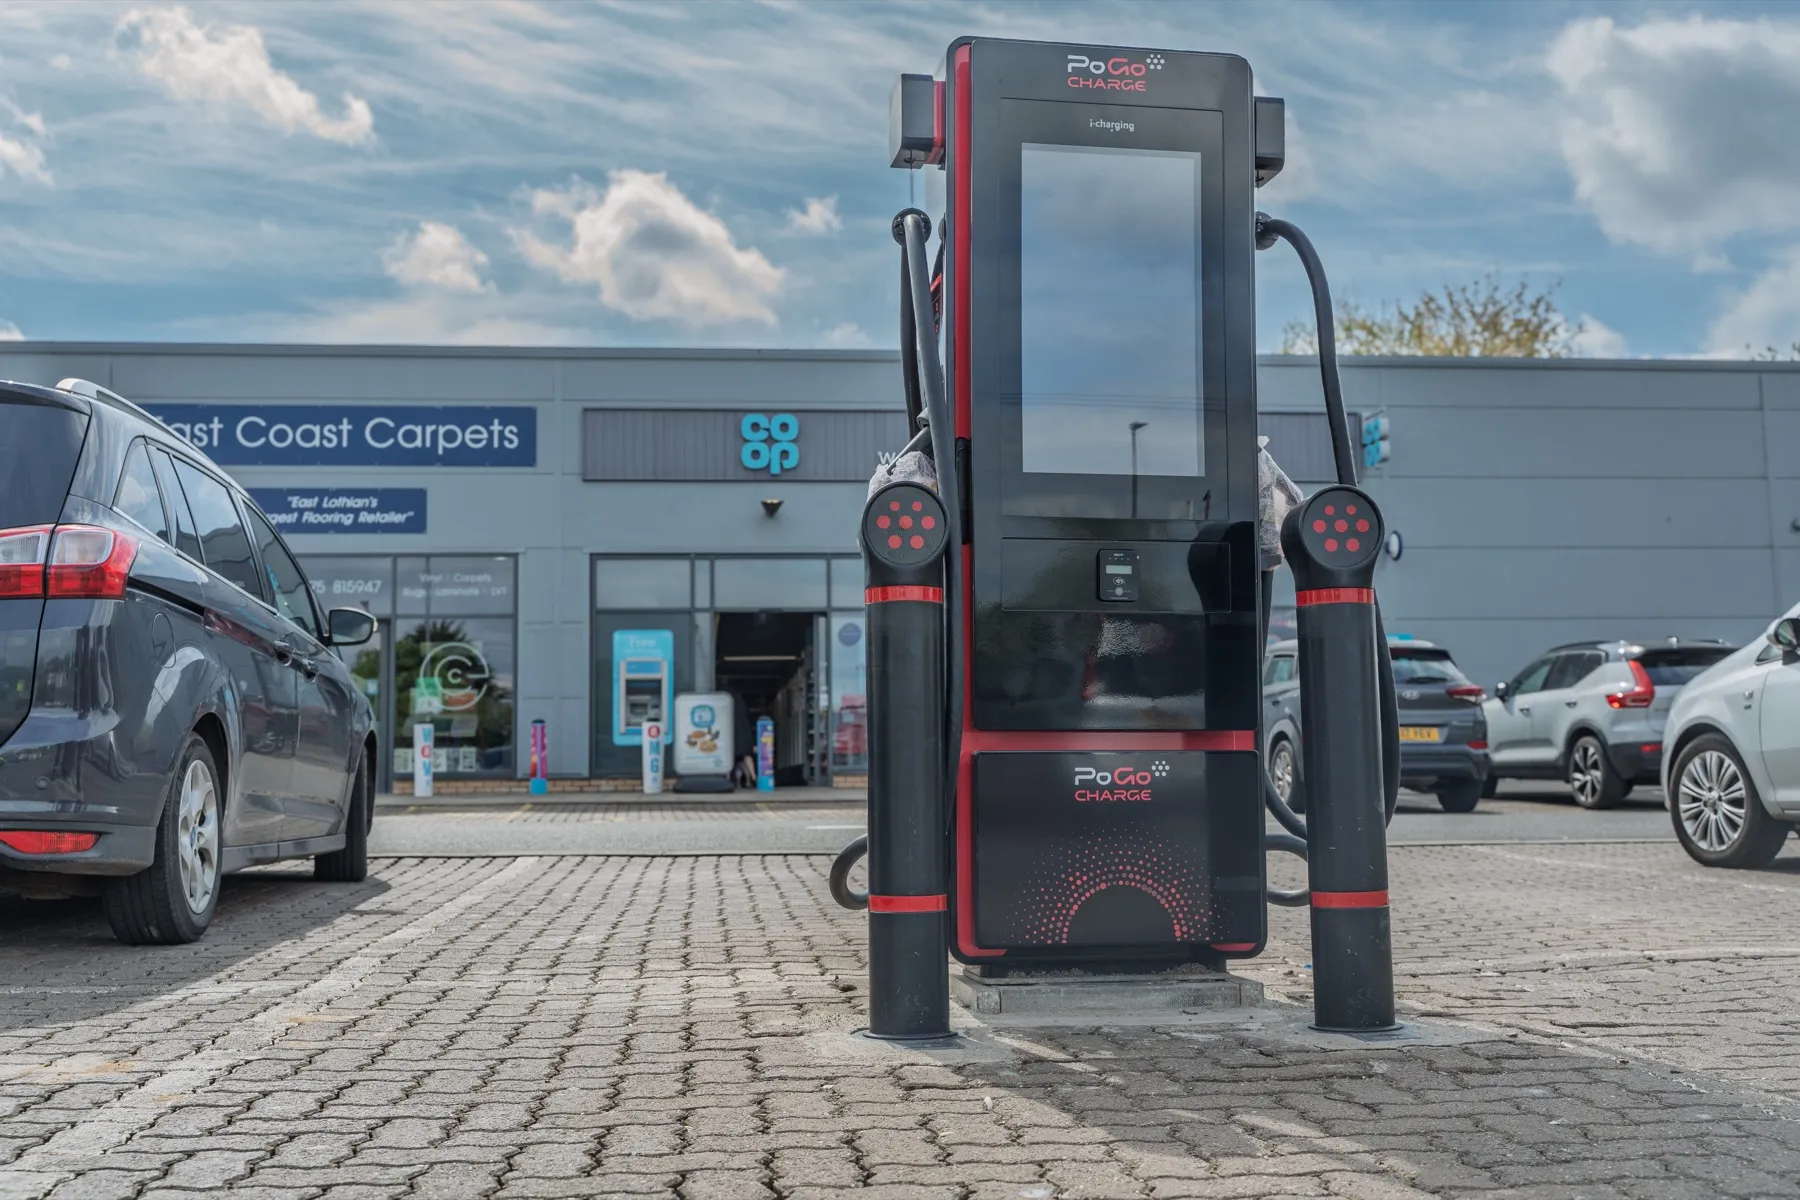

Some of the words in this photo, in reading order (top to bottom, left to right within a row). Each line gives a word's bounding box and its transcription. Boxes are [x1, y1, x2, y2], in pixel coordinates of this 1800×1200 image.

[1067, 54, 1147, 77] PoGo
[1067, 76, 1147, 92] CHARGE
[1089, 118, 1135, 132] i-charging
[157, 415, 224, 448] ast
[235, 415, 353, 448] Coast
[364, 417, 519, 455] Carpets
[322, 497, 378, 509] Lothian's
[301, 511, 355, 526] Flooring
[332, 579, 382, 594] 815947
[1074, 767, 1152, 786] PoGo
[1074, 789, 1152, 801] CHARGE
